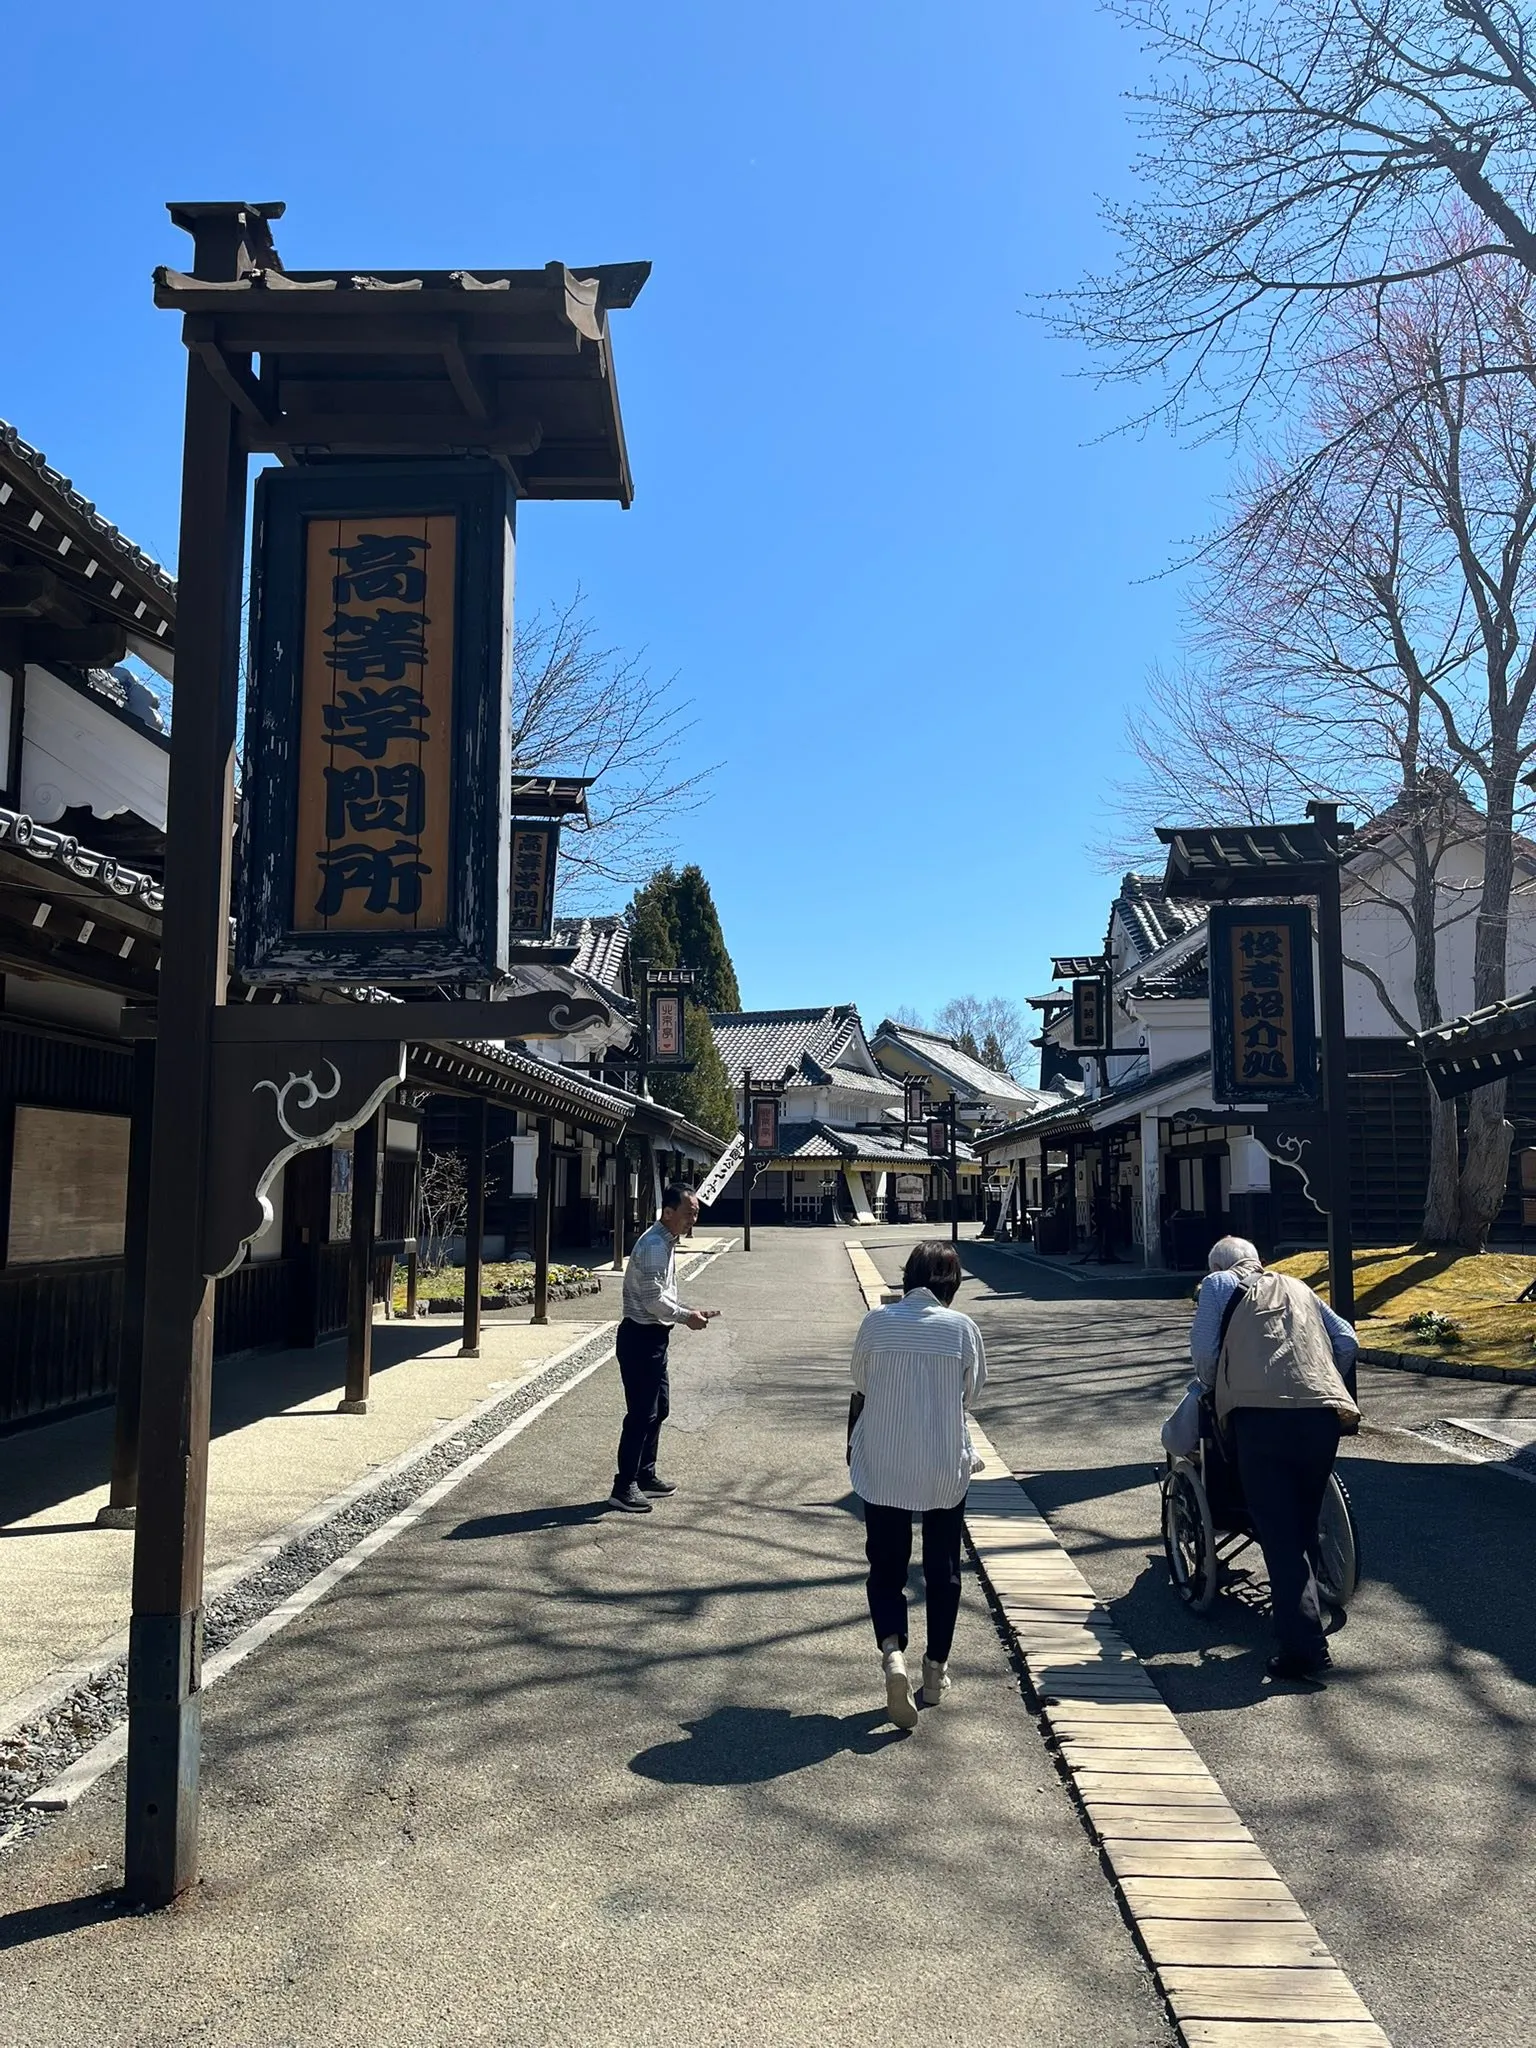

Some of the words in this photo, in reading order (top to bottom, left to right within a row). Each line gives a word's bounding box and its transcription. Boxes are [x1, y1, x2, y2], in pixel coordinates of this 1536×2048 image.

[313, 533, 433, 915] 高等学問所
[511, 833, 543, 928] 高等学問所
